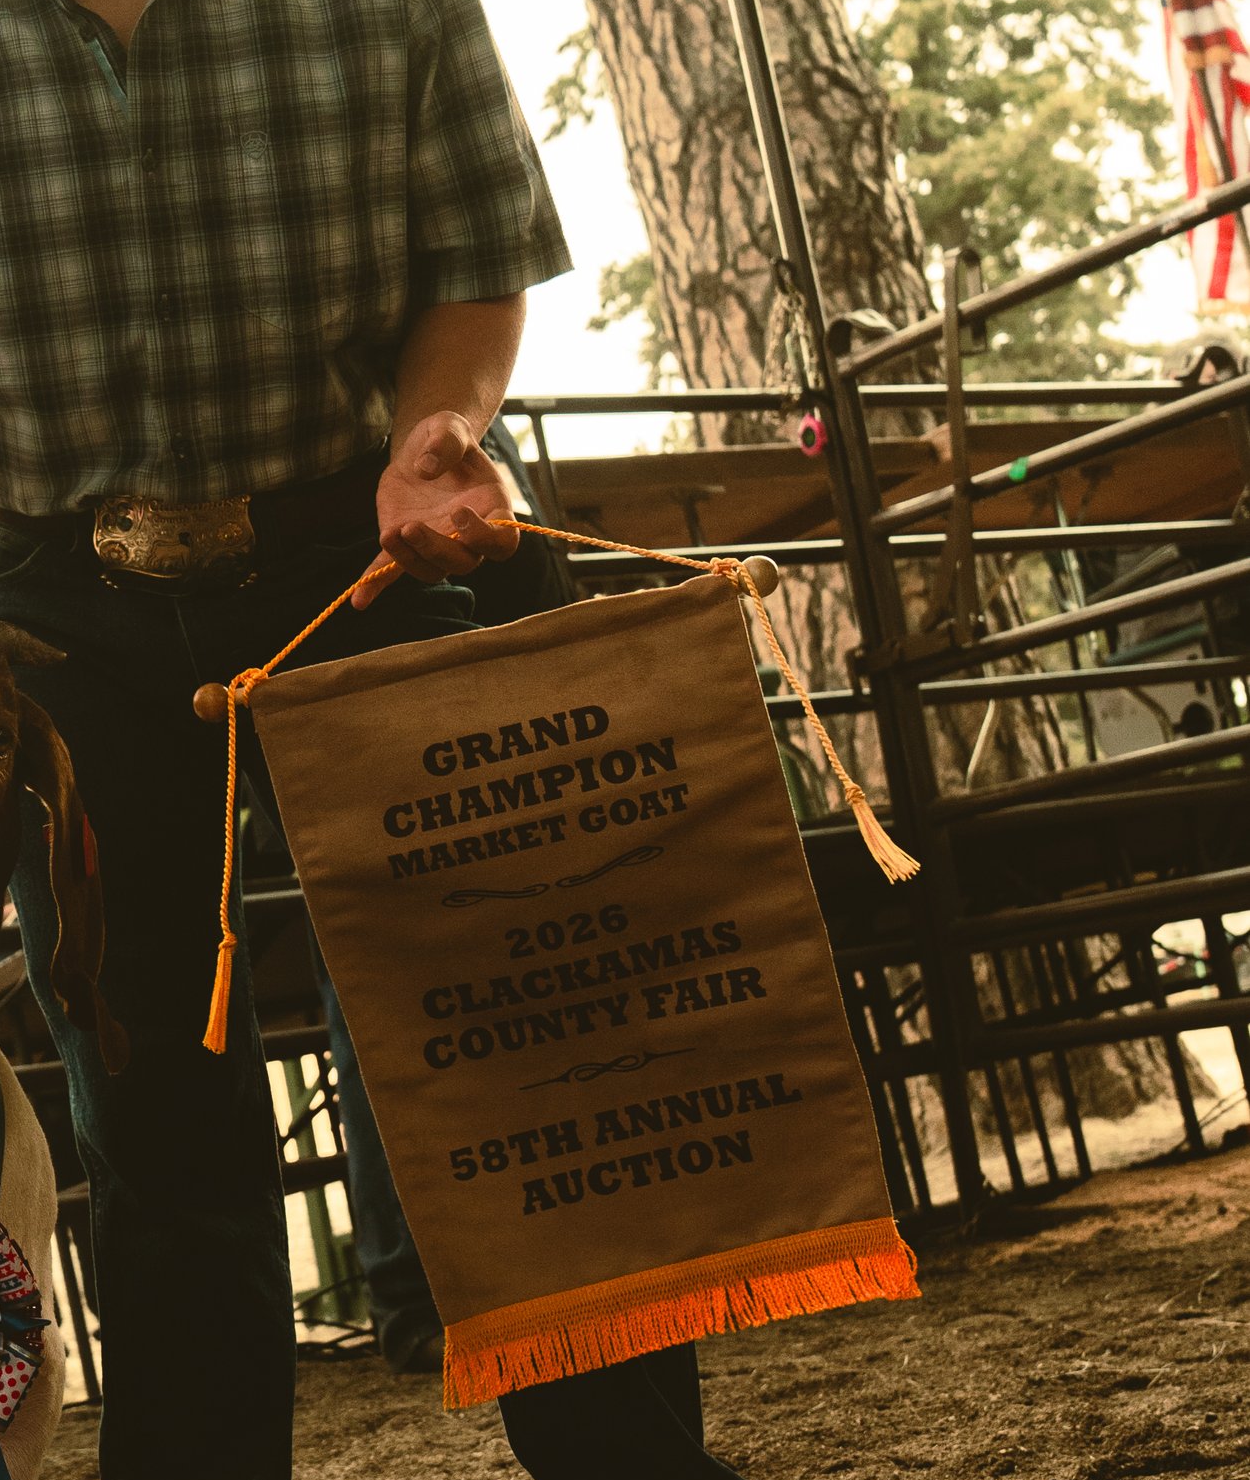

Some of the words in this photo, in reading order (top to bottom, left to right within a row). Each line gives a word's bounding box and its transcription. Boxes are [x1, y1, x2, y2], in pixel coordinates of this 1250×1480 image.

[382, 736, 679, 839] CHAMPION
[421, 704, 610, 778] GRAND
[387, 818, 568, 880] MARKET
[582, 782, 690, 836] GOAT
[421, 919, 743, 1020] CLACKAMAS
[503, 903, 629, 960] 2026
[422, 993, 631, 1071] COUNTY
[645, 965, 767, 1021] FAIR
[447, 1117, 581, 1183] 58TH
[594, 1072, 803, 1146] ANNUAL
[521, 1129, 755, 1217] AUCTION
